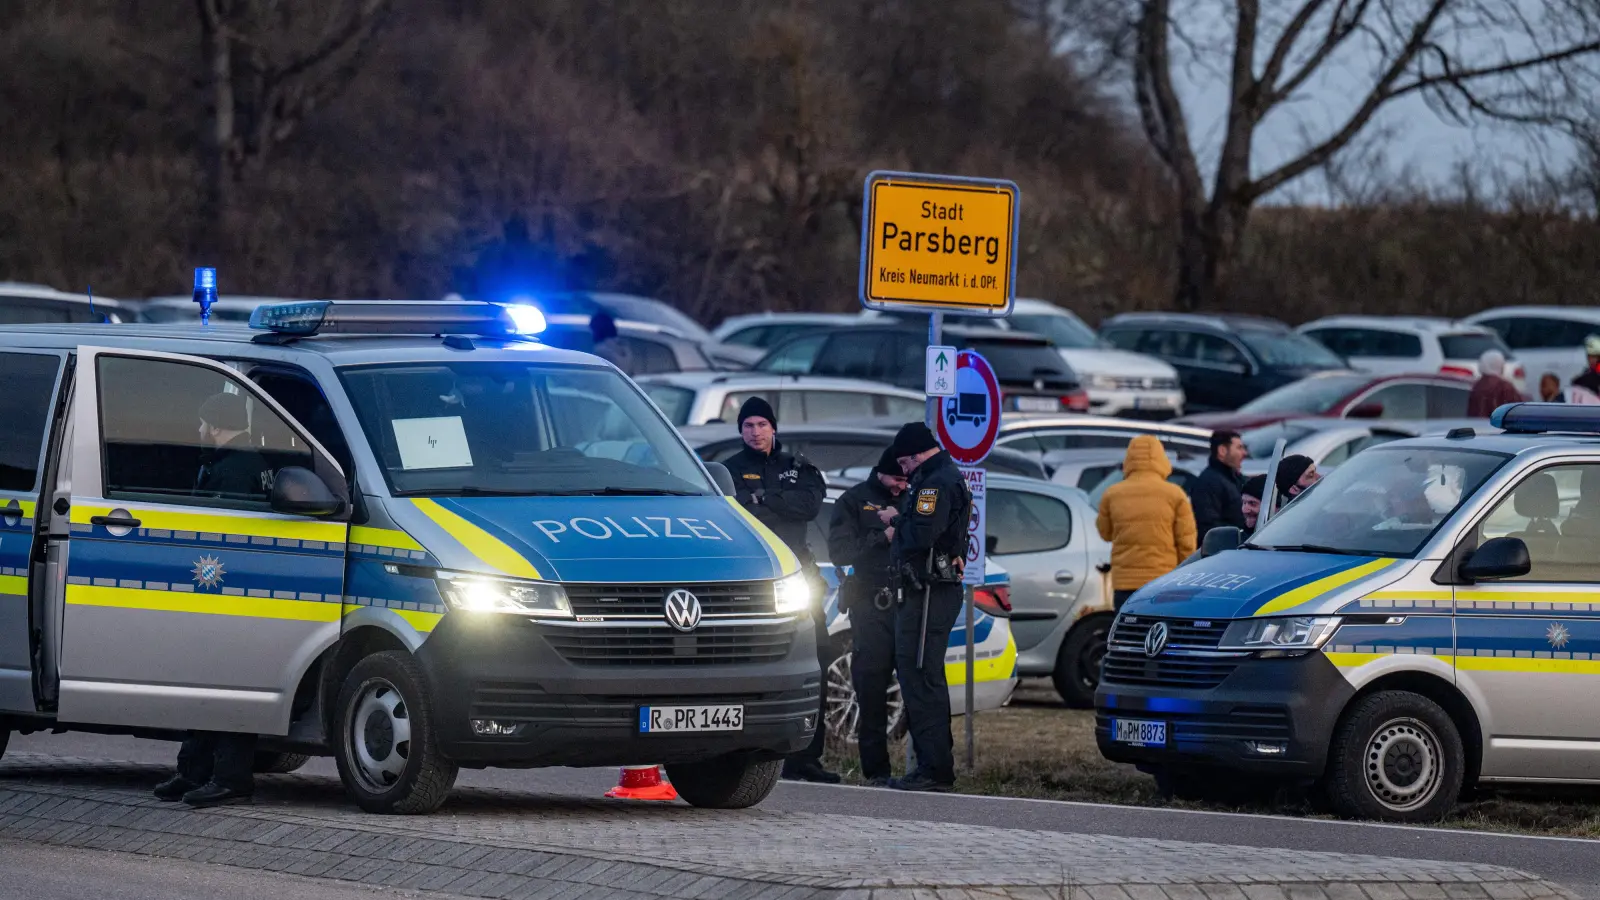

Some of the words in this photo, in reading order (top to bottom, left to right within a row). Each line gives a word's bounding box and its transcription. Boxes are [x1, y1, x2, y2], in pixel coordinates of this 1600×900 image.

[921, 200, 964, 221] Stadt
[882, 222, 999, 264] Parsberg
[880, 267, 905, 284] Kreis
[909, 268, 960, 287] Neumarkt
[532, 516, 733, 543] POLIZEI
[1161, 572, 1257, 591] POLIZEI
[674, 708, 696, 729] PR
[700, 707, 742, 728] 1443
[1140, 723, 1165, 742] 8873
